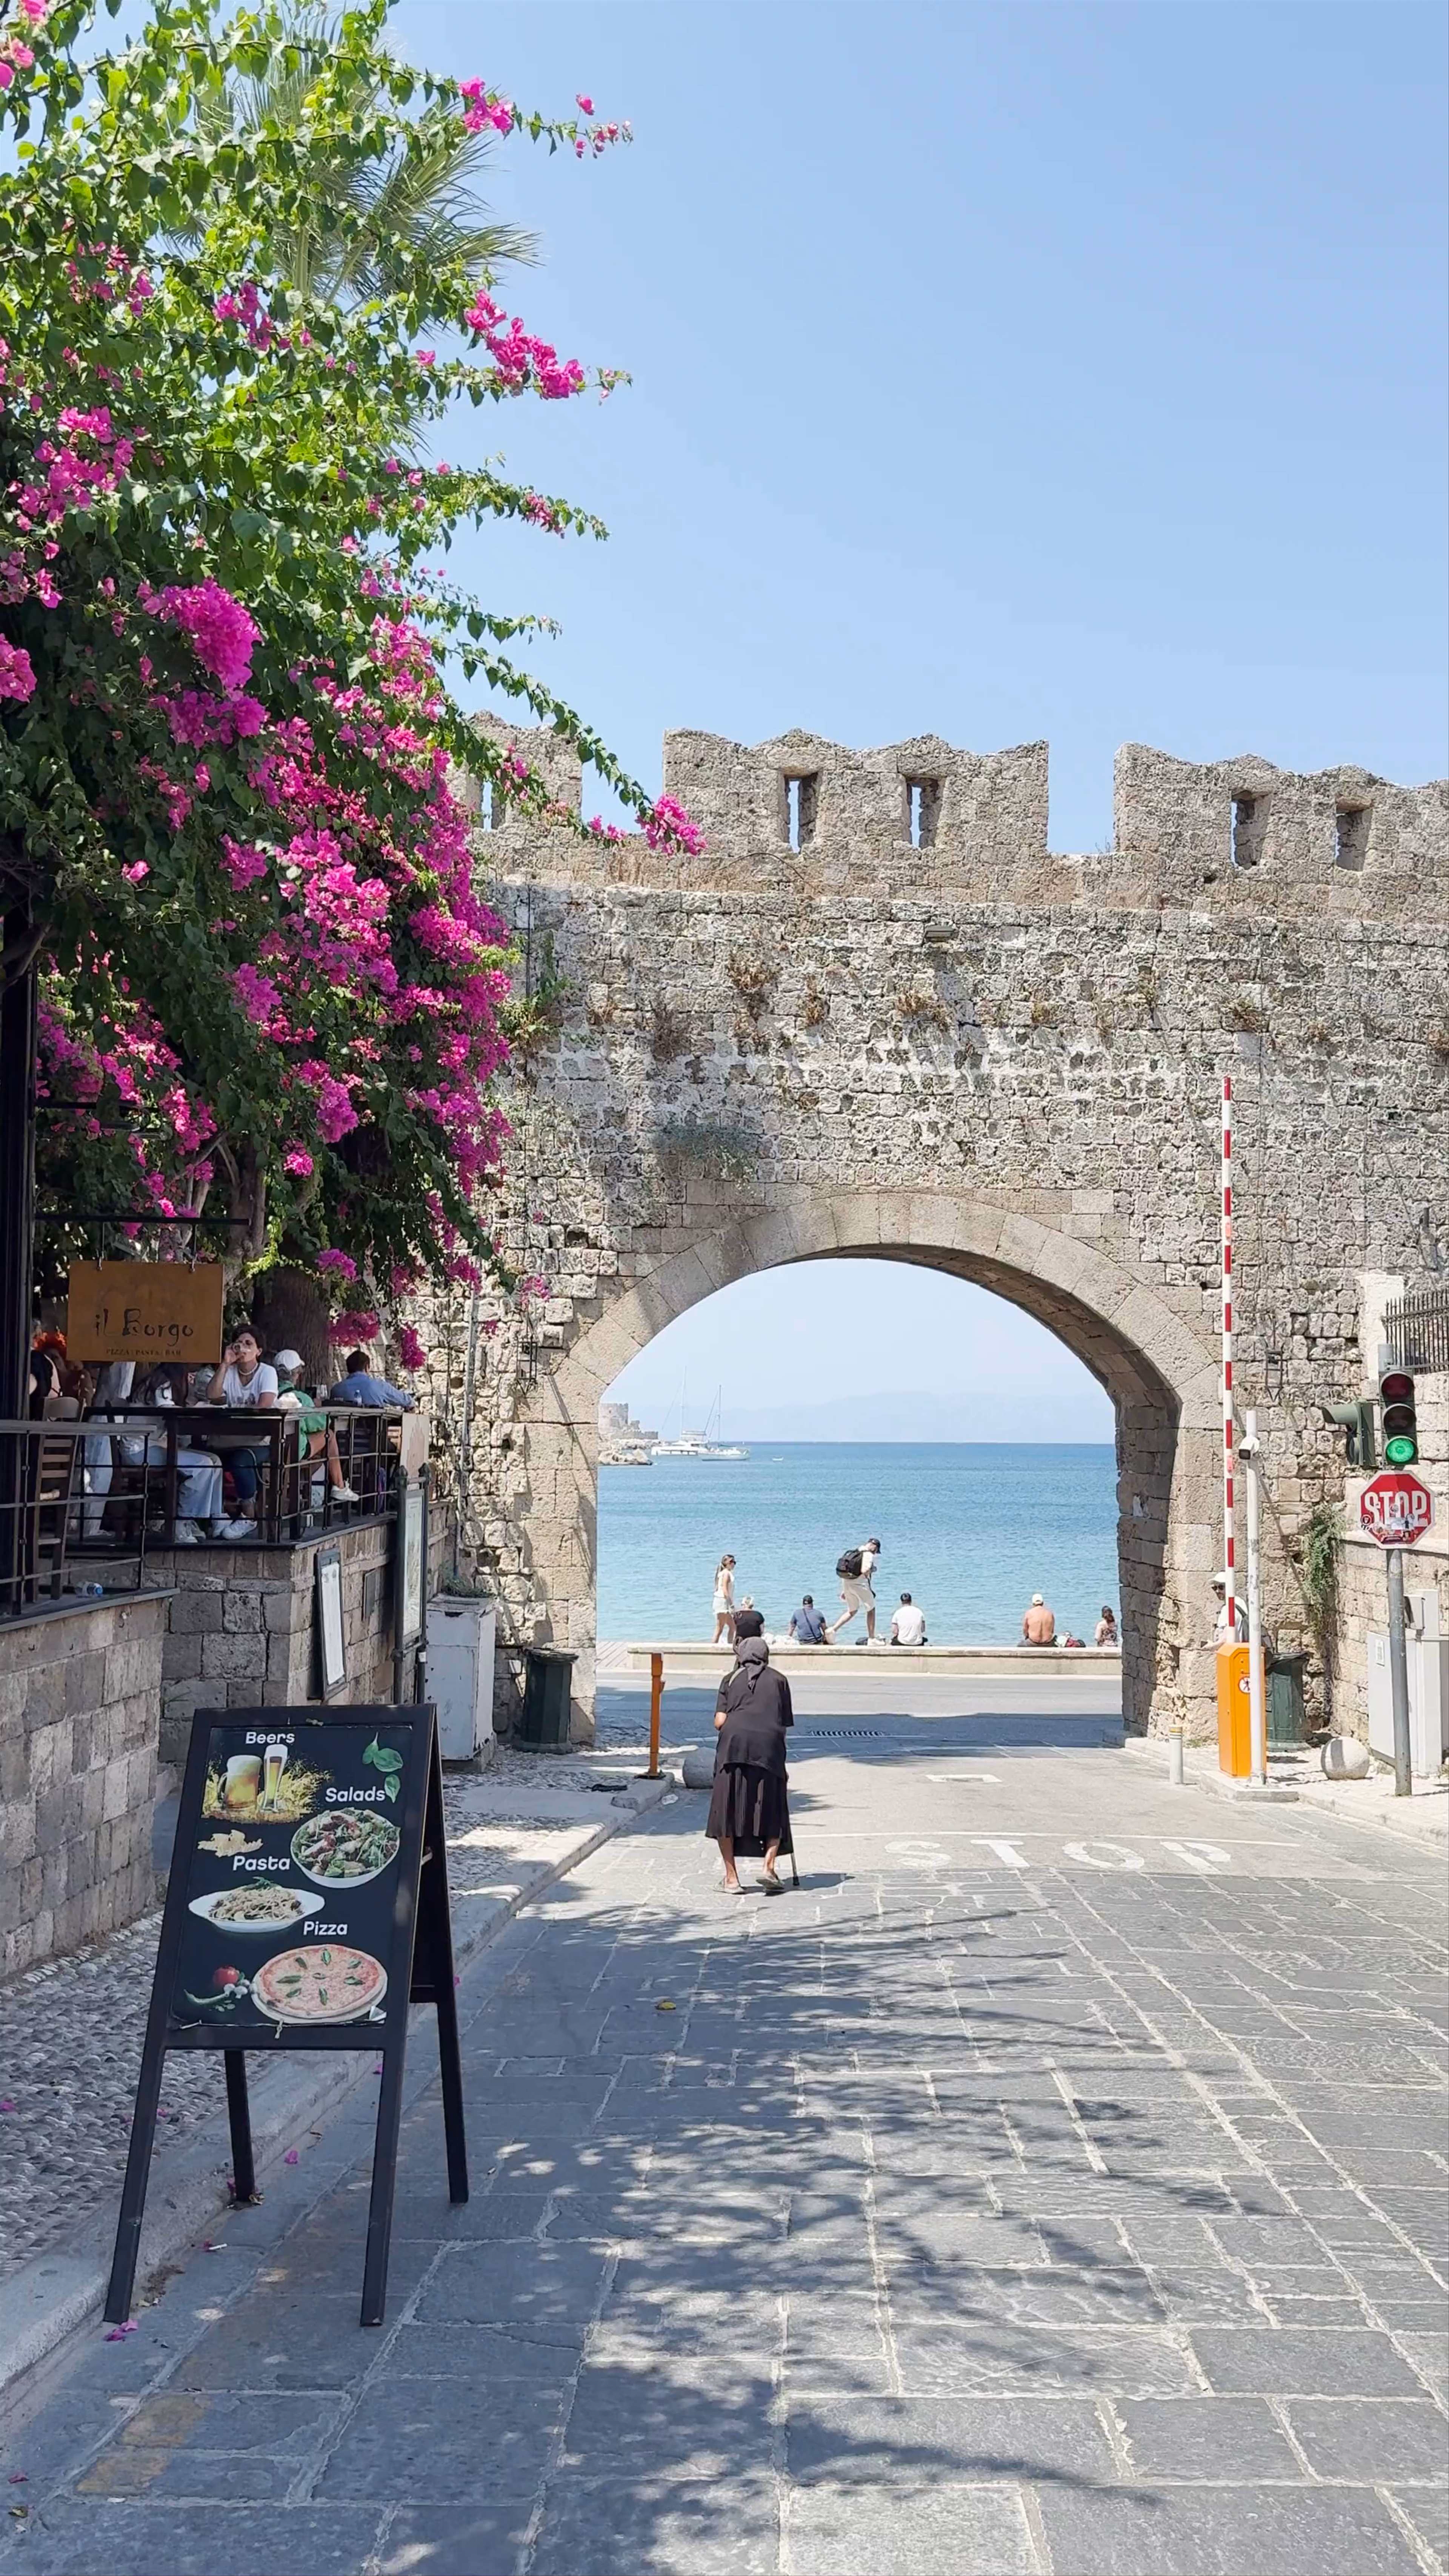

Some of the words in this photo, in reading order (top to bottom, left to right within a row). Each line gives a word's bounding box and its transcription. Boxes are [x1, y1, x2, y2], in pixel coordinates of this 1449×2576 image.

[122, 1308, 194, 1347] Borgo
[1364, 1490, 1427, 1527] STOP
[245, 1731, 295, 1744] Beers
[325, 1786, 386, 1802] Salads
[232, 1855, 291, 1871] Pasta
[884, 1839, 1231, 1875] STOP
[303, 1921, 348, 1936] Pizza
